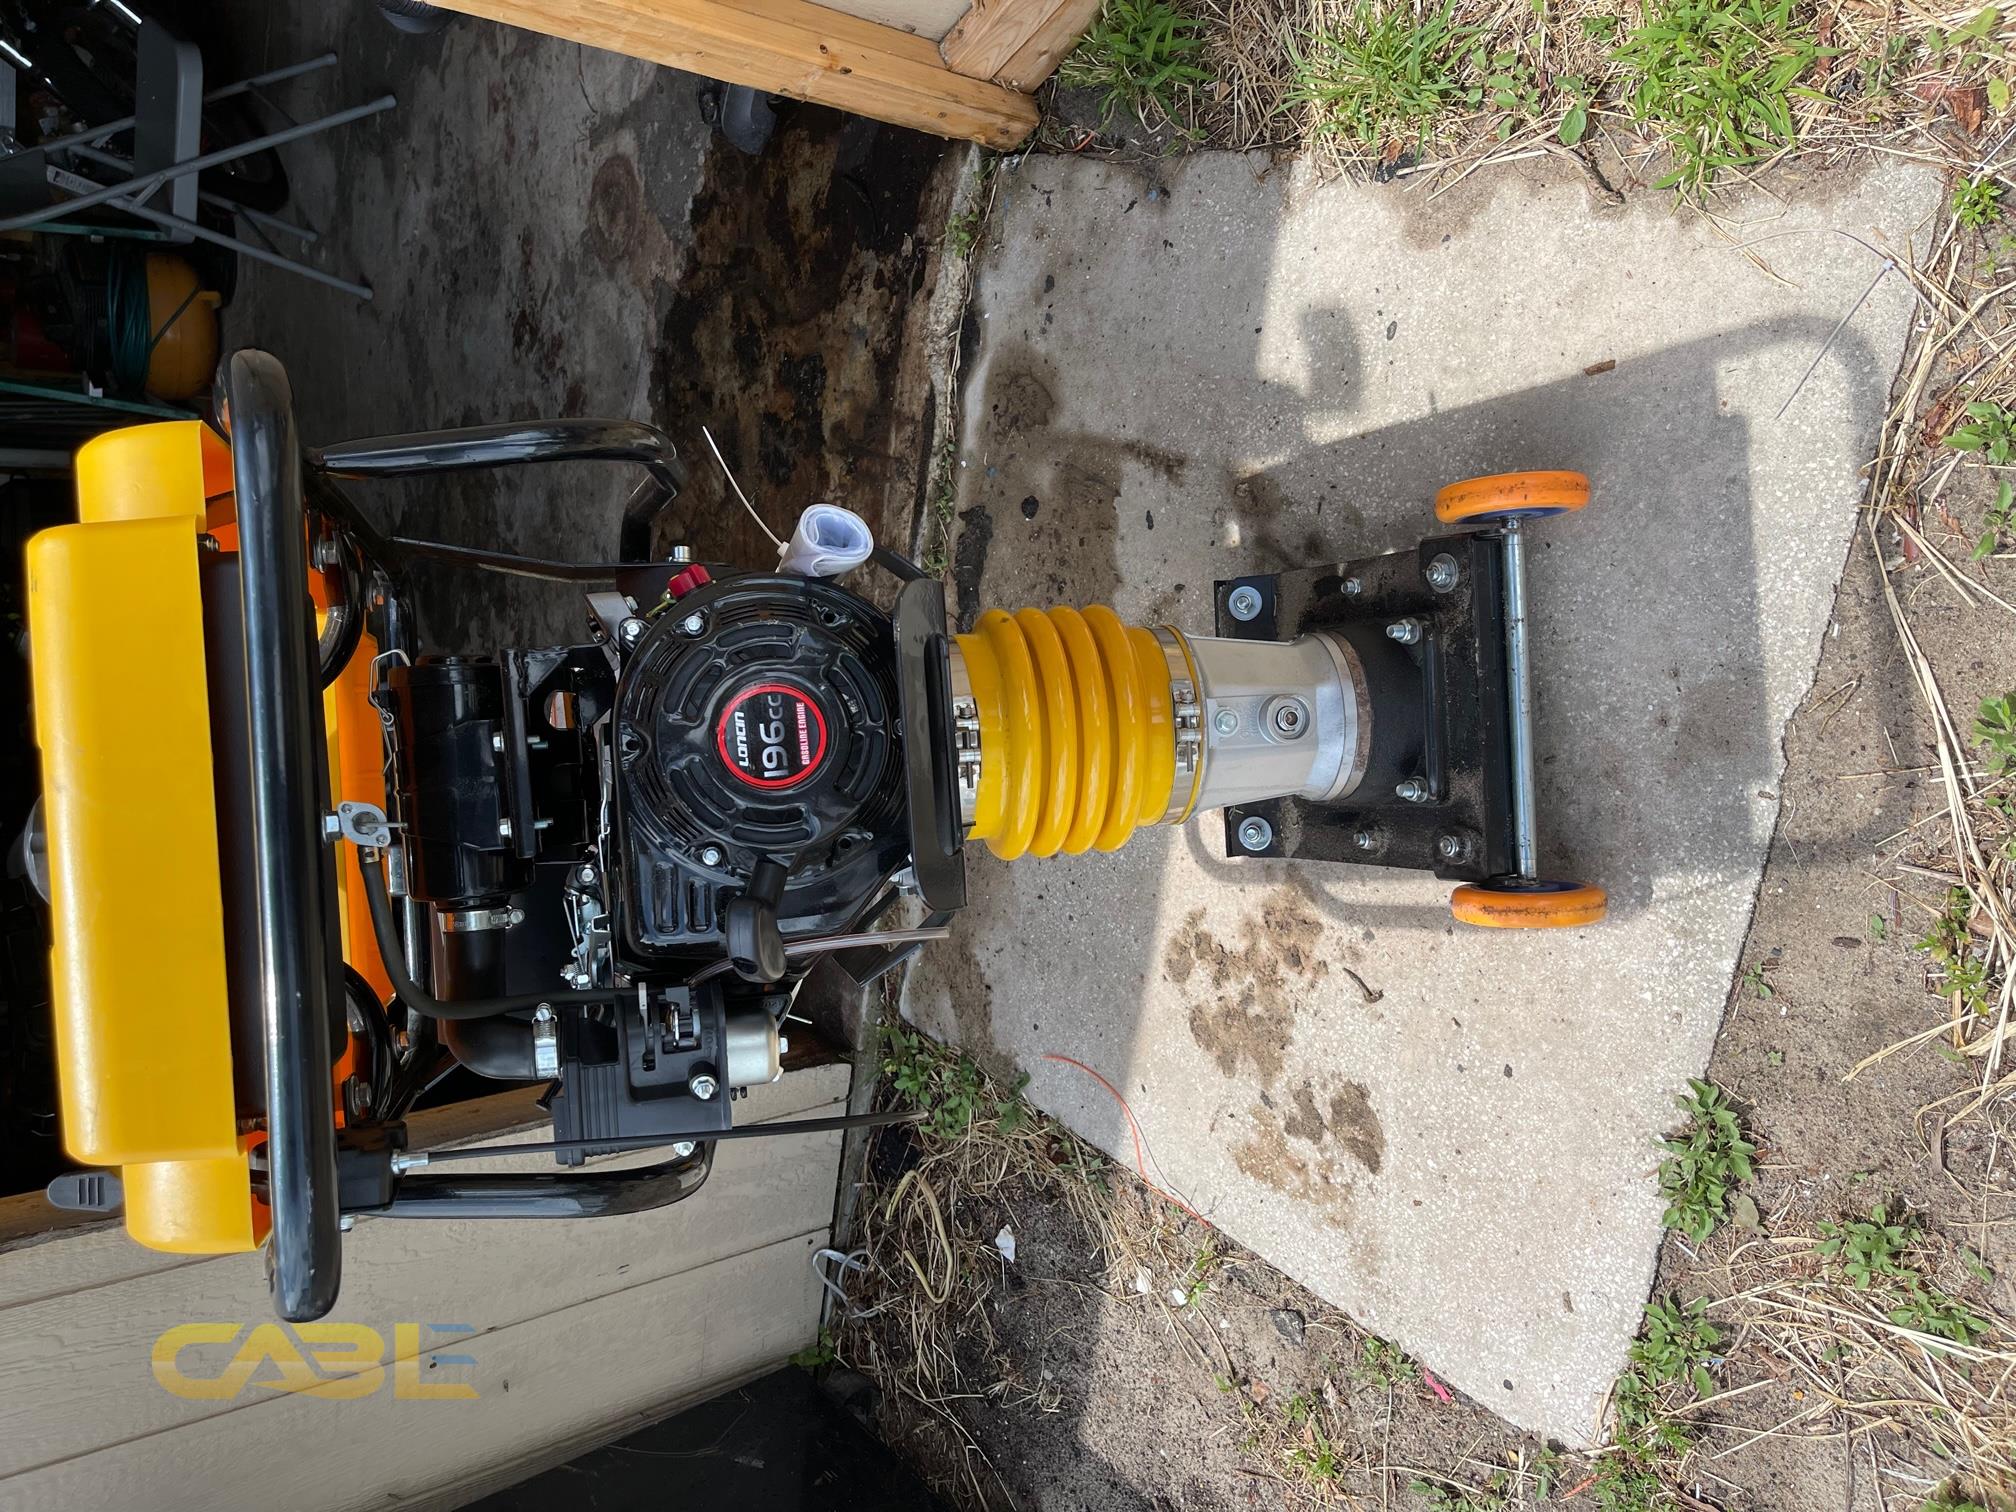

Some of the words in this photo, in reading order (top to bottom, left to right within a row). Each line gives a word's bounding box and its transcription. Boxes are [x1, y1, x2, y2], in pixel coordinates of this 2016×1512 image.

[796, 702, 807, 728] ENGINE
[759, 695, 789, 777] 196cc
[798, 729, 810, 765] GASOLINE
